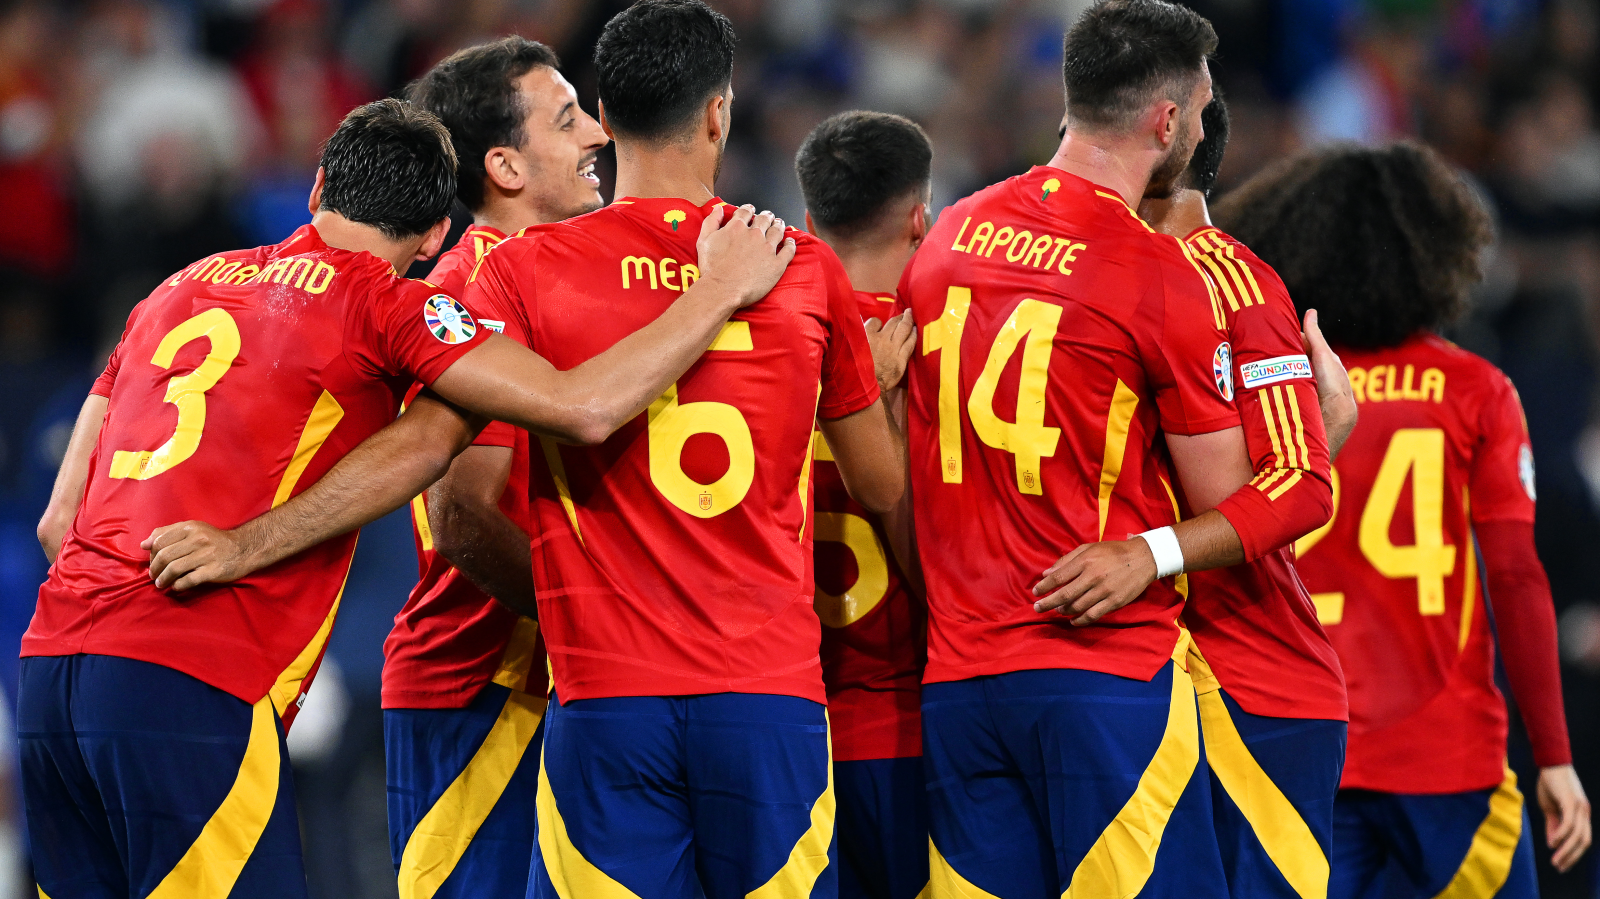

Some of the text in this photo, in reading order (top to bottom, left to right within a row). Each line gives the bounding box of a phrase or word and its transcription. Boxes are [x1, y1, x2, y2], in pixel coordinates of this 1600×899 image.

[621, 255, 699, 292] MER
[951, 217, 1086, 275] LAPORTE
[109, 308, 241, 480] 3
[923, 285, 1063, 495] 14
[1243, 362, 1310, 380] FOUNDATION
[1347, 364, 1446, 404] RELLA
[648, 320, 753, 518] 6
